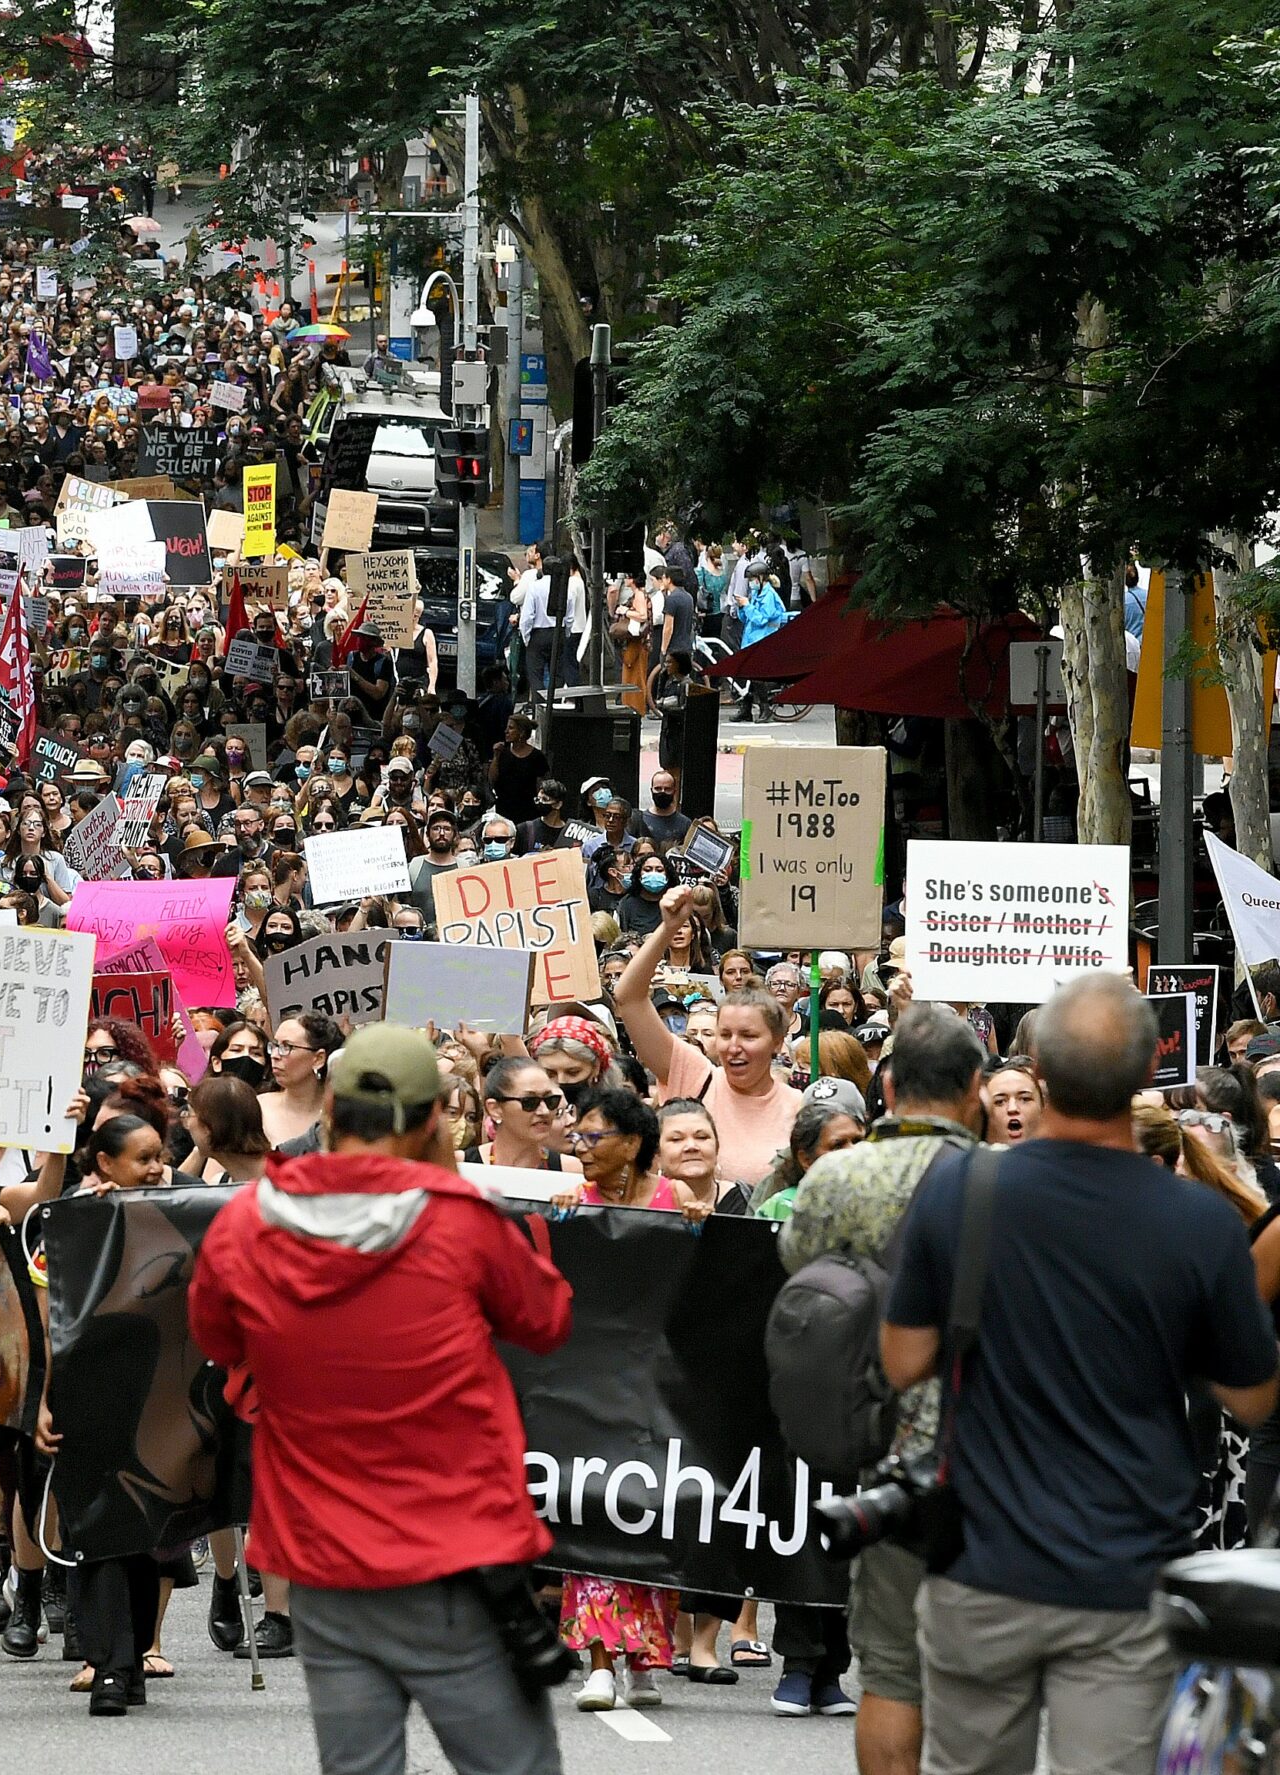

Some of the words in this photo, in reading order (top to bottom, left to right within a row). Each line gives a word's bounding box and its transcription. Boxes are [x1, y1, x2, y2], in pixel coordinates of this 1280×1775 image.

[145, 427, 169, 444] WE
[174, 427, 214, 445] WILL
[145, 444, 172, 458] NOT
[183, 444, 203, 457] BE
[156, 457, 213, 475] SILENT
[247, 484, 272, 502] STOP
[247, 502, 272, 512] VIOLENCE
[247, 512, 272, 524] AGAINST
[363, 556, 381, 569] HEY
[383, 555, 409, 567] SCOMO
[367, 569, 387, 580] MAKE
[389, 568, 400, 578] ME
[401, 569, 409, 577] A
[366, 581, 409, 593] SANDWICH
[231, 646, 253, 656] COVID
[35, 736, 78, 768] ENOUGH
[39, 762, 57, 781] IS
[765, 779, 860, 807] #MeToo
[776, 812, 836, 838] 1988
[759, 852, 764, 874] I
[772, 857, 807, 875] was
[815, 853, 853, 883] only
[456, 858, 562, 918] DIE
[925, 879, 983, 902] She's
[989, 880, 1111, 905] someone's
[791, 884, 817, 913] 19
[926, 910, 991, 933] Sister
[1013, 912, 1093, 936] Mother
[928, 941, 1032, 967] Daughter
[1053, 944, 1104, 967] Wife
[33, 986, 70, 1027] TO
